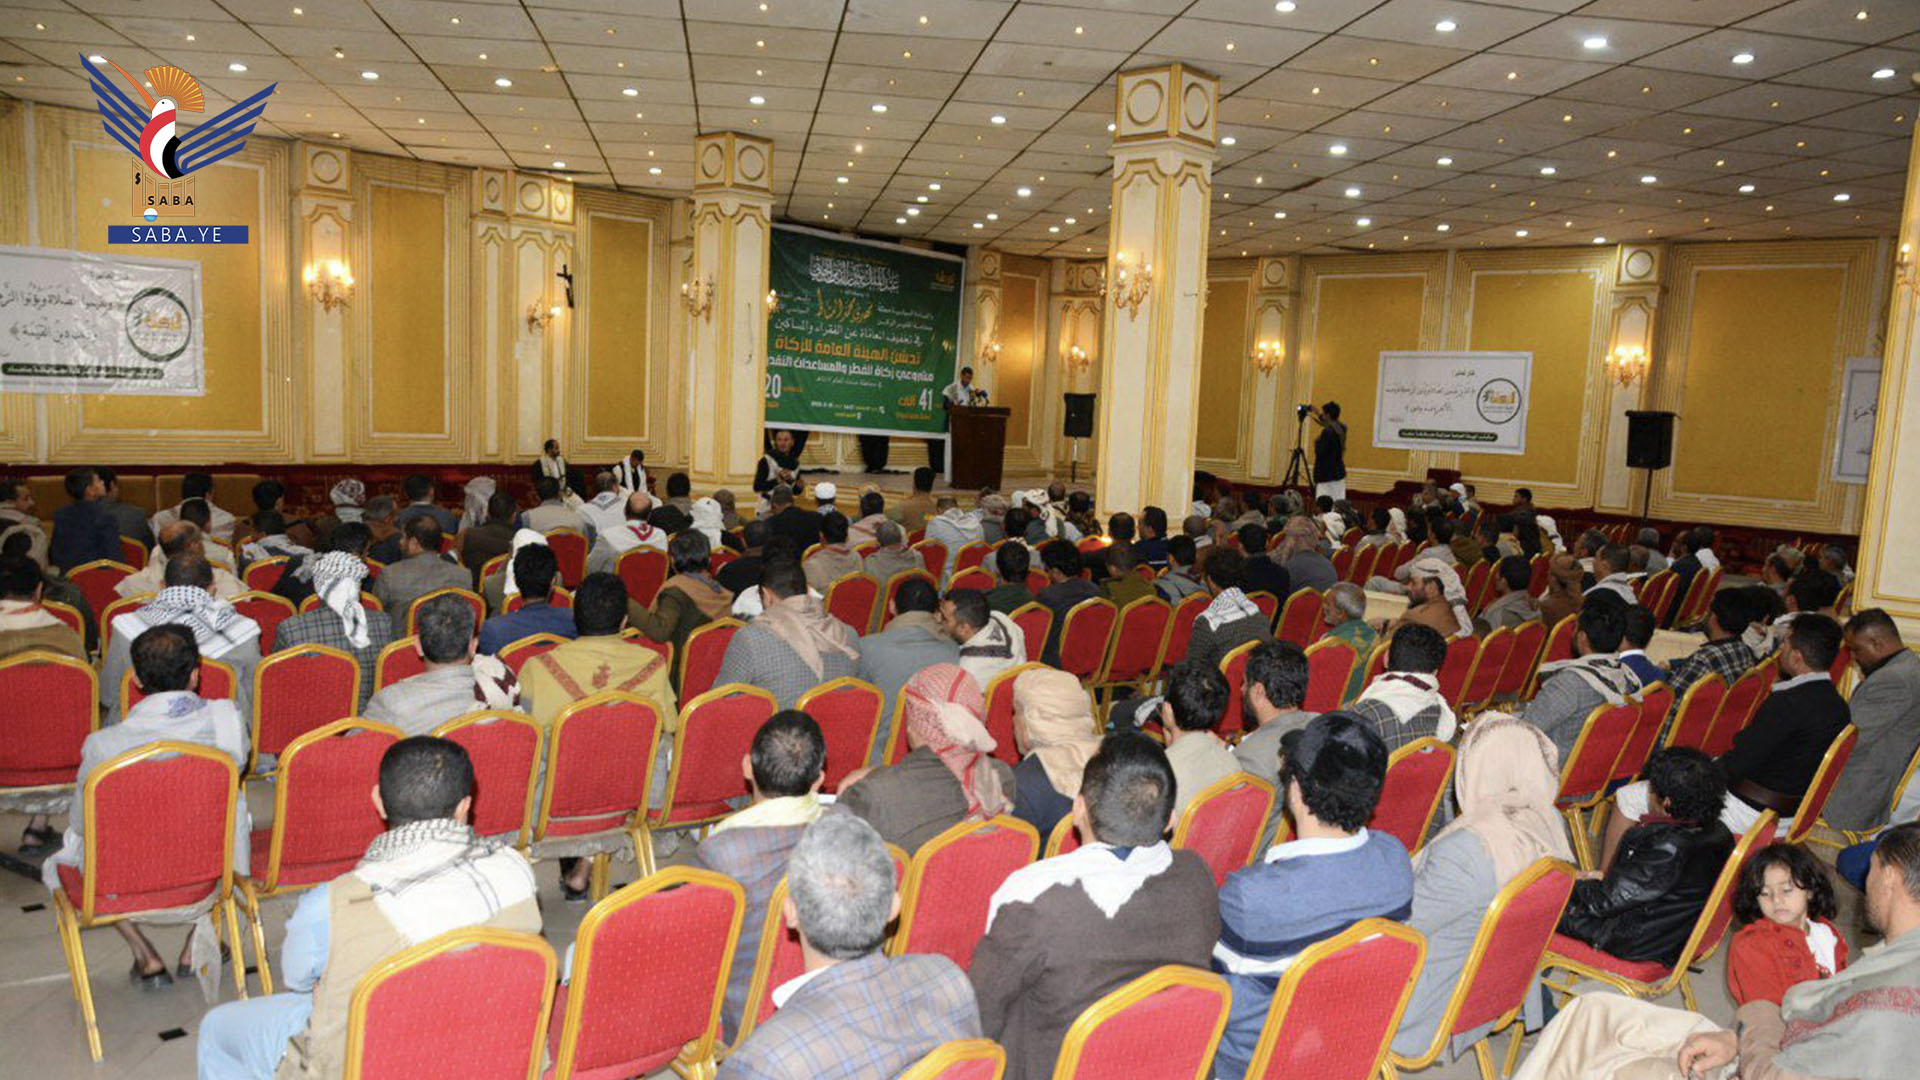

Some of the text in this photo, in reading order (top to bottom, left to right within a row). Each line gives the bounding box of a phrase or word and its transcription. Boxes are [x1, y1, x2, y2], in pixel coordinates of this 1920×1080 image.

[775, 317, 814, 335] والمساكين
[815, 323, 843, 337] الفقراء
[775, 335, 812, 353] للزكاة
[814, 339, 851, 357] العامة
[853, 344, 888, 361] الهيئة
[793, 356, 847, 374] والمساعدات
[874, 364, 895, 379] زكاة
[919, 388, 934, 411] 41
